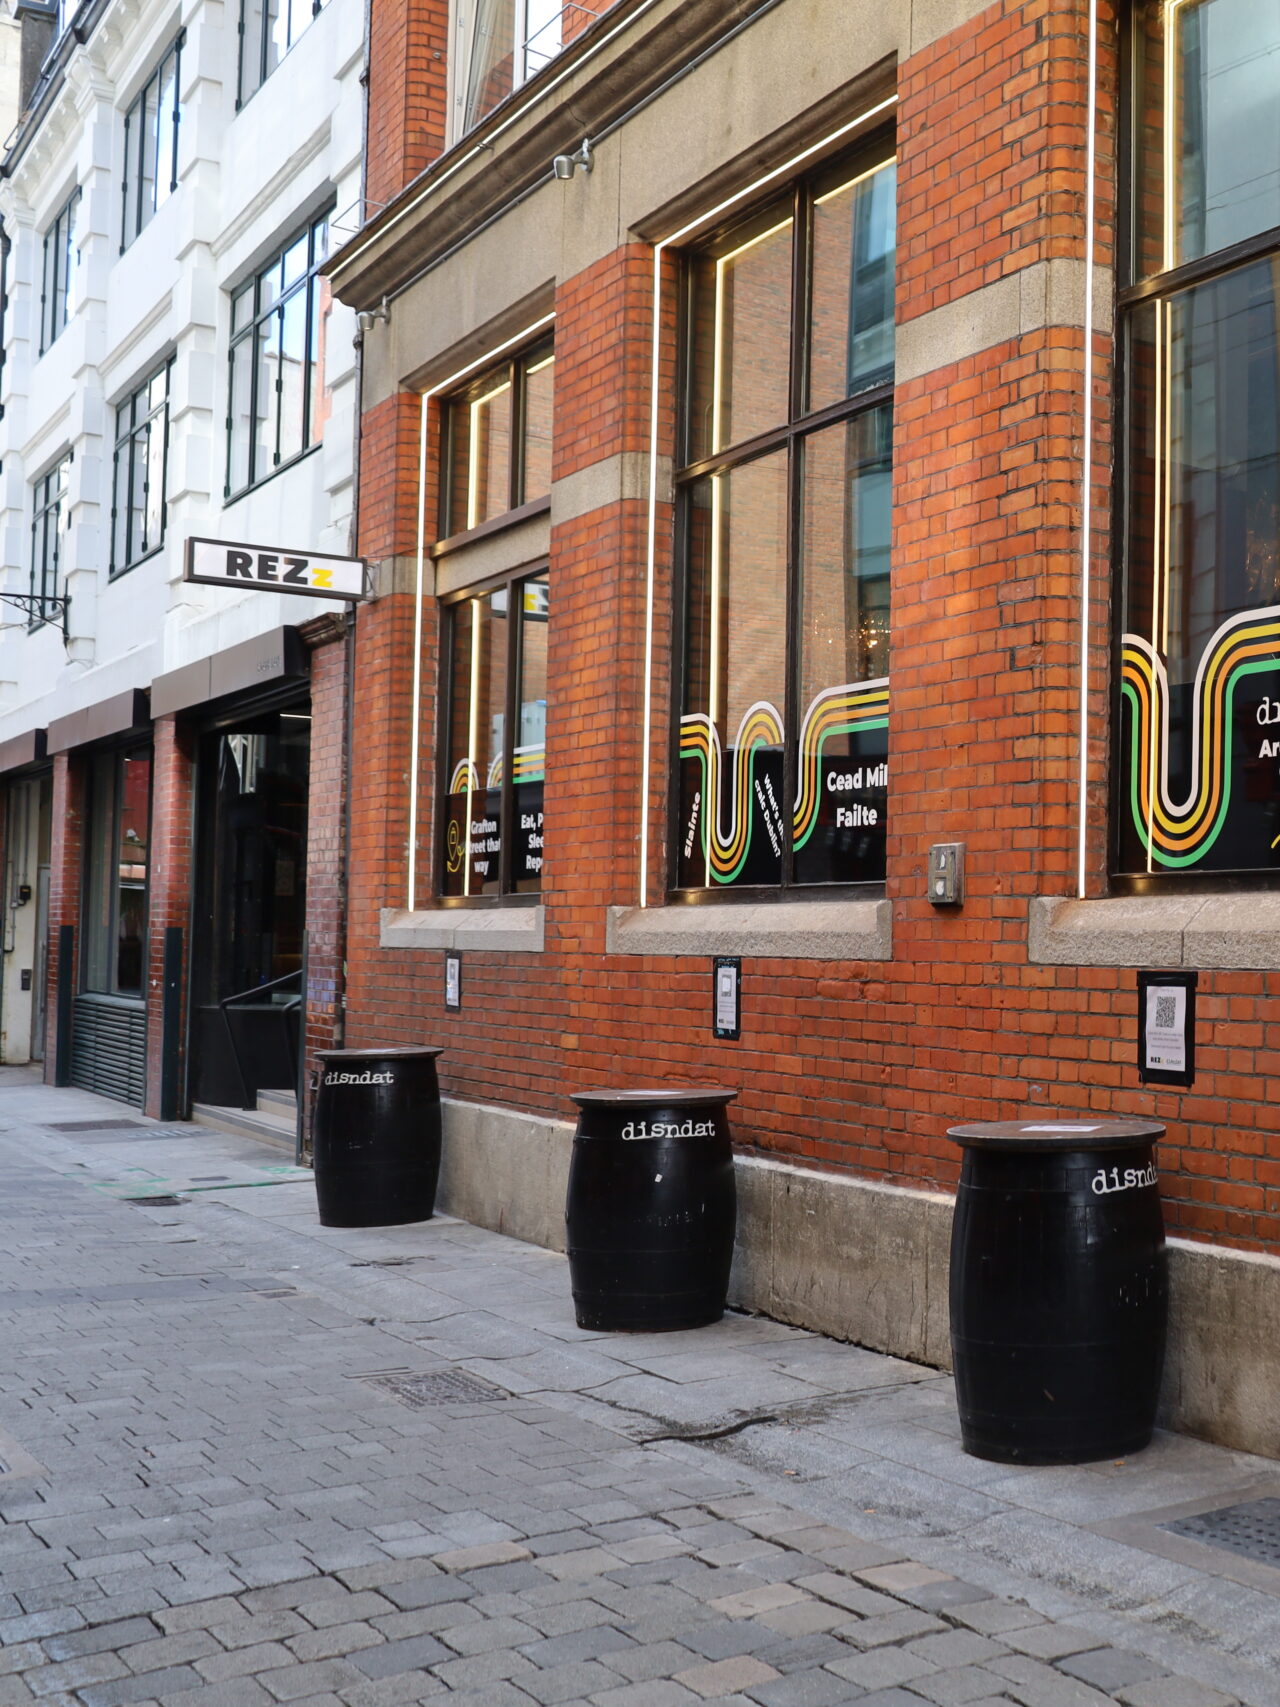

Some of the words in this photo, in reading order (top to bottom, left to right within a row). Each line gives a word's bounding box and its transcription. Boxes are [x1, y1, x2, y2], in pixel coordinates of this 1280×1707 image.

[827, 767, 863, 792] Cead
[866, 763, 888, 788] Mil
[521, 814, 537, 831] Eat,
[684, 791, 701, 859] Slainte
[836, 803, 878, 828] Failte
[471, 818, 497, 834] Grafton
[764, 808, 781, 858] Dublin?
[469, 839, 486, 854] treet
[486, 837, 501, 852] that
[473, 860, 490, 876] way
[525, 854, 543, 873] Rep
[325, 1070, 395, 1086] disndat
[621, 1119, 716, 1141] disndat
[1091, 1161, 1158, 1195] disnd
